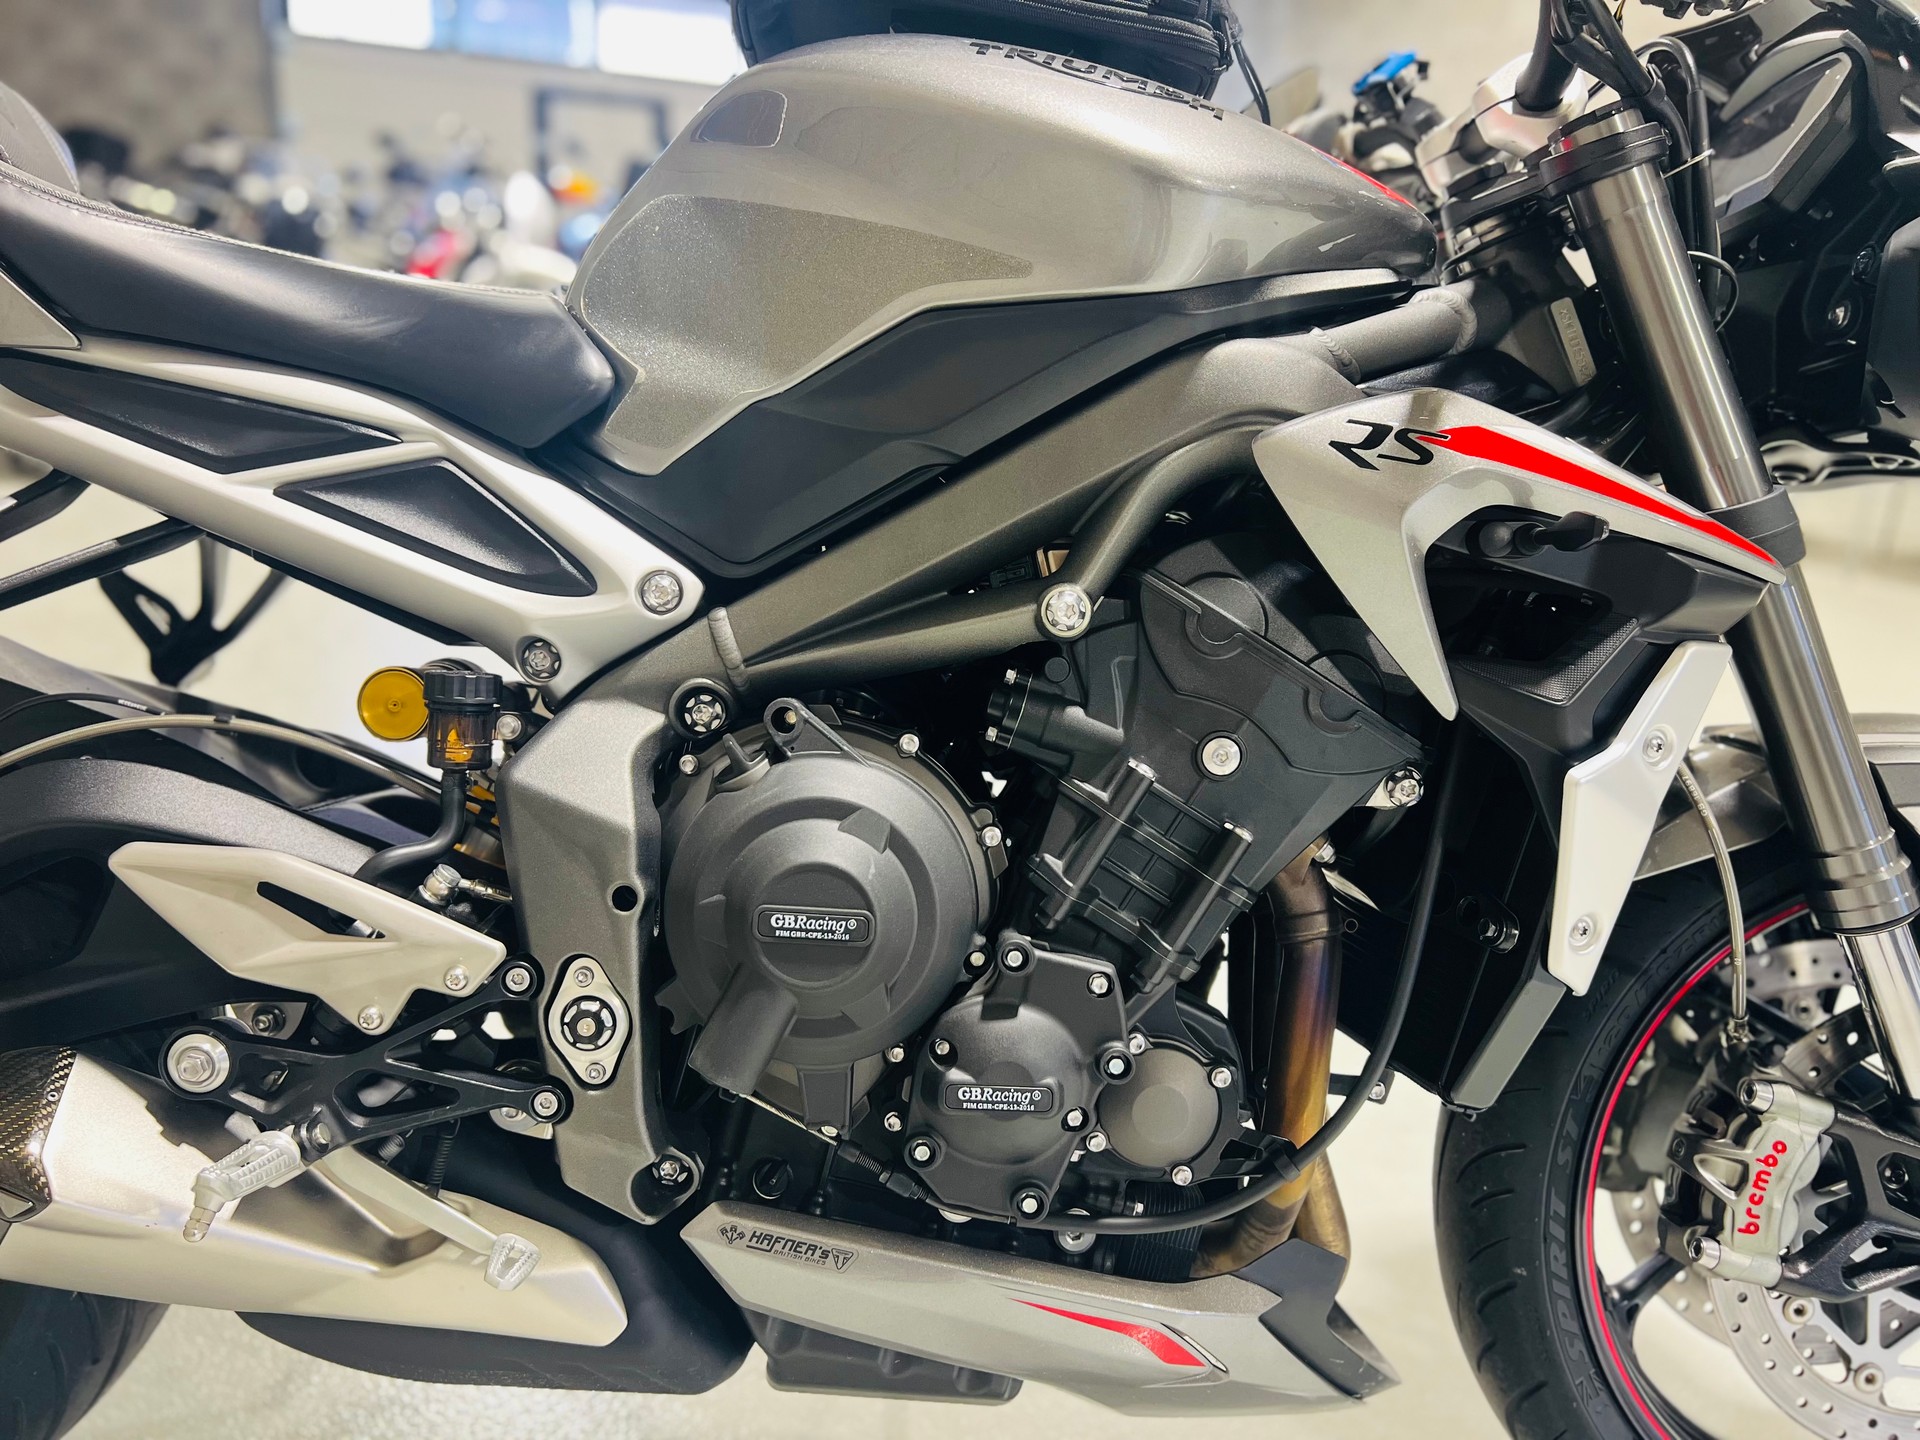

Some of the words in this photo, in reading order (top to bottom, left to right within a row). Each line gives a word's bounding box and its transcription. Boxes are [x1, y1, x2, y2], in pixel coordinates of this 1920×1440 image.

[969, 41, 1224, 121] TRIUMPH
[1328, 418, 1450, 472] RS
[775, 929, 790, 937] FIM
[1556, 1108, 1580, 1175] ST
[1736, 1140, 1788, 1235] brembo
[772, 1249, 803, 1261] BRITISH
[804, 1255, 827, 1266] BIKES
[1548, 1186, 1589, 1364] SPIRIT
